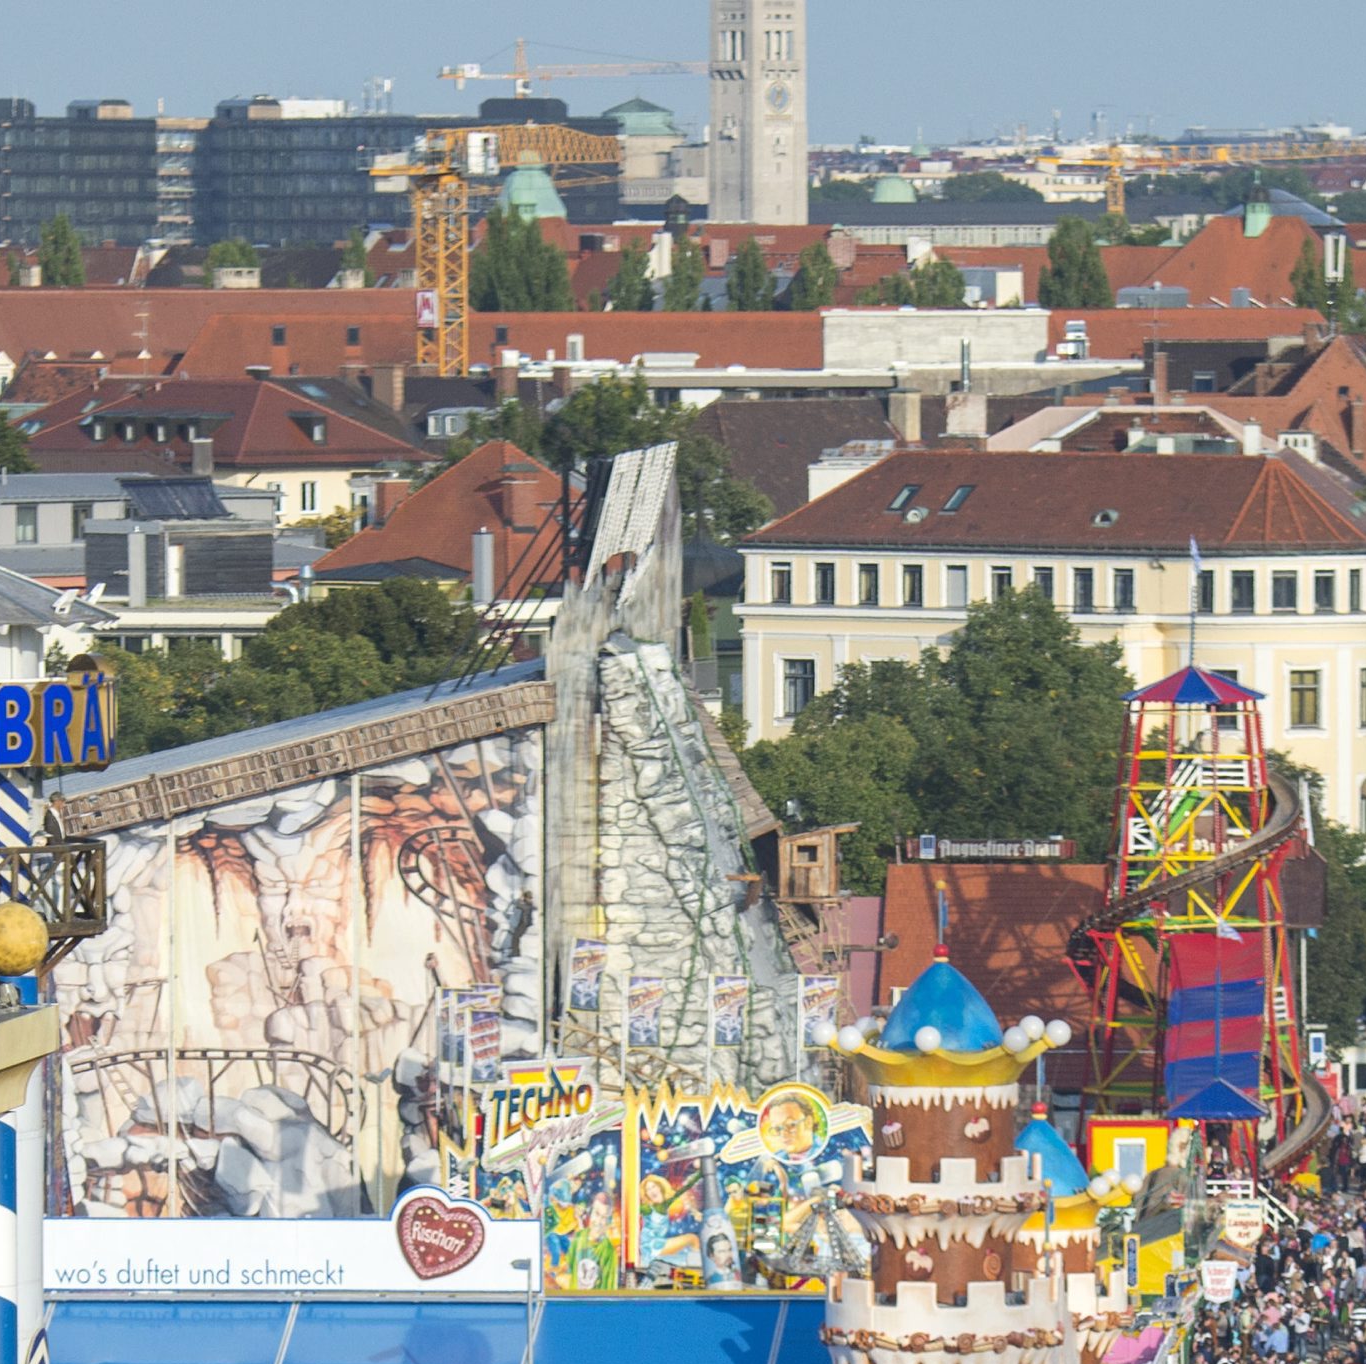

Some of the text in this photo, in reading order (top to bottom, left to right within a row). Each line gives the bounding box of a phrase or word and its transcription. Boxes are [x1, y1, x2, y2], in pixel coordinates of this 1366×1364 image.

[489, 1064, 593, 1149] TECHNO
[412, 1222, 466, 1254] Rischart
[55, 1259, 345, 1285] wo's duftet und schmeckt
